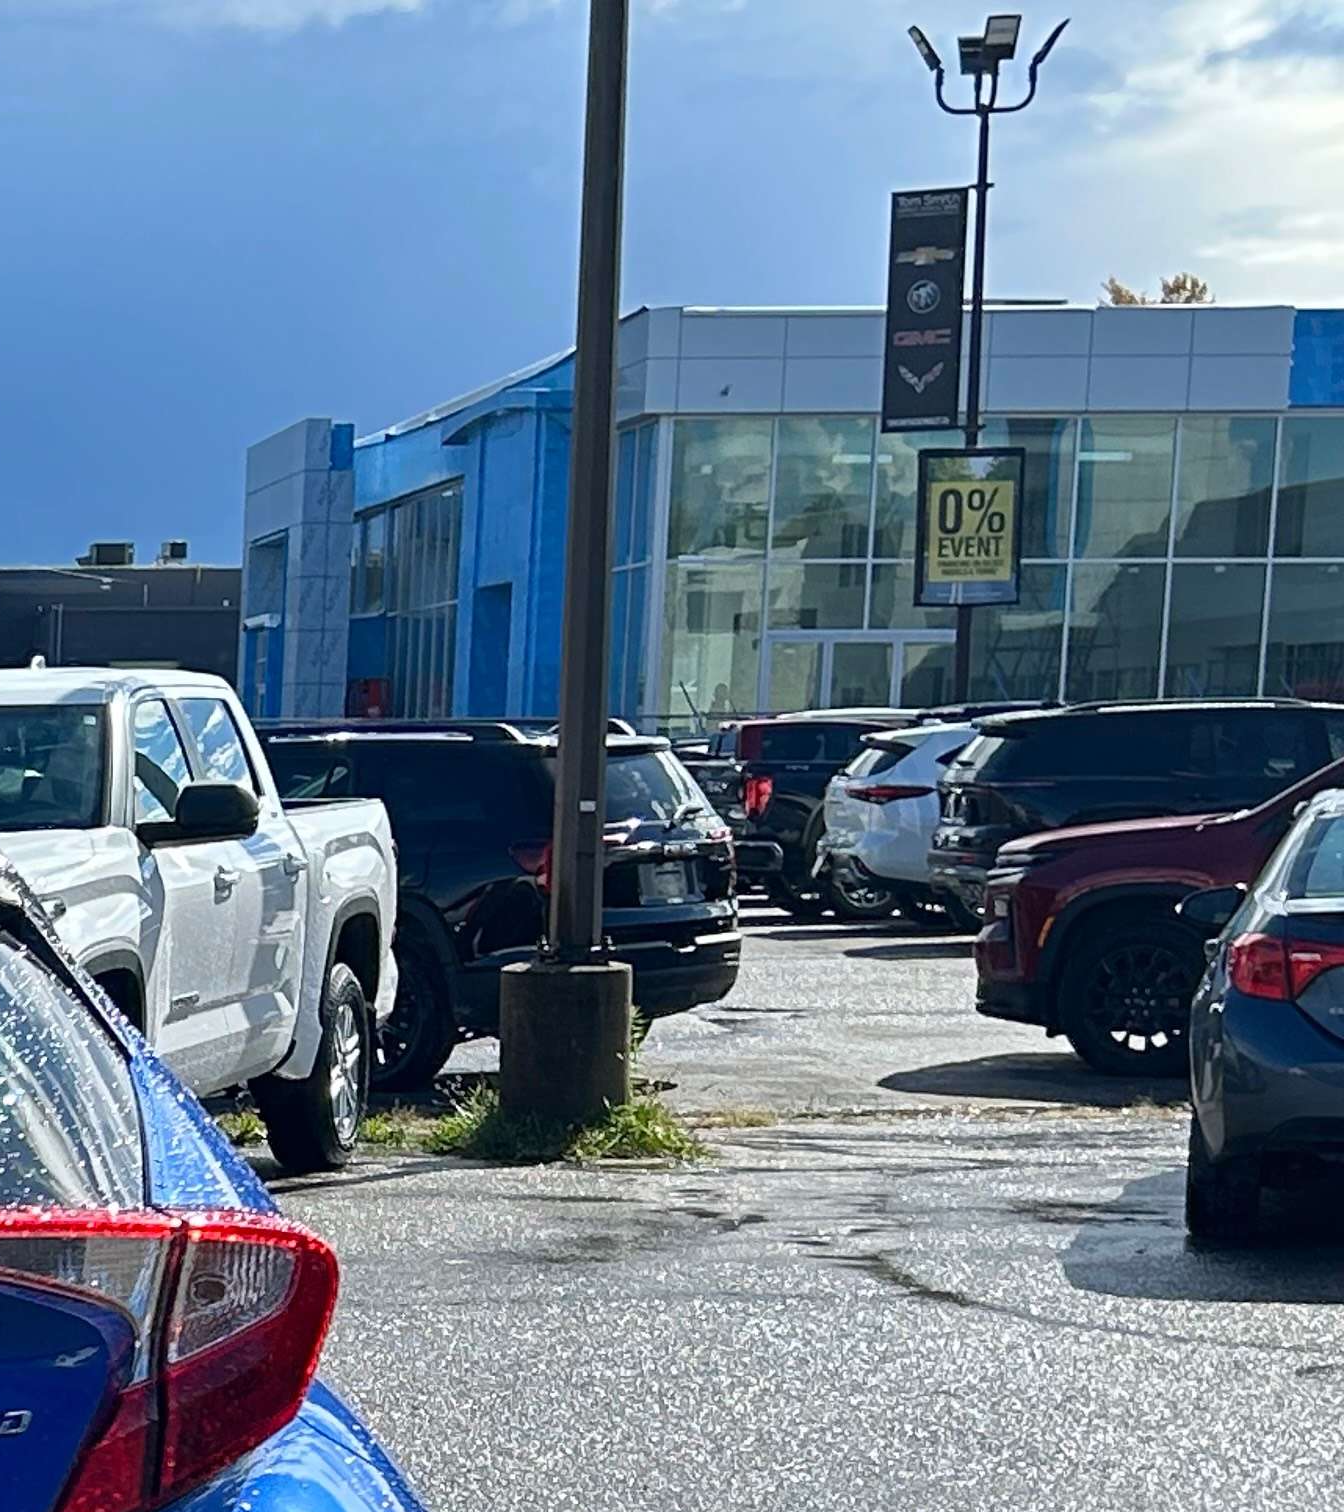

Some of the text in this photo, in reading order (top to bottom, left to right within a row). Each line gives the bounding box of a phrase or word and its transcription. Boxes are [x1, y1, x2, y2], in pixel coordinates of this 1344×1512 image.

[894, 327, 951, 347] GMC
[938, 487, 1005, 534] 0%
[937, 536, 1004, 558] EVENT
